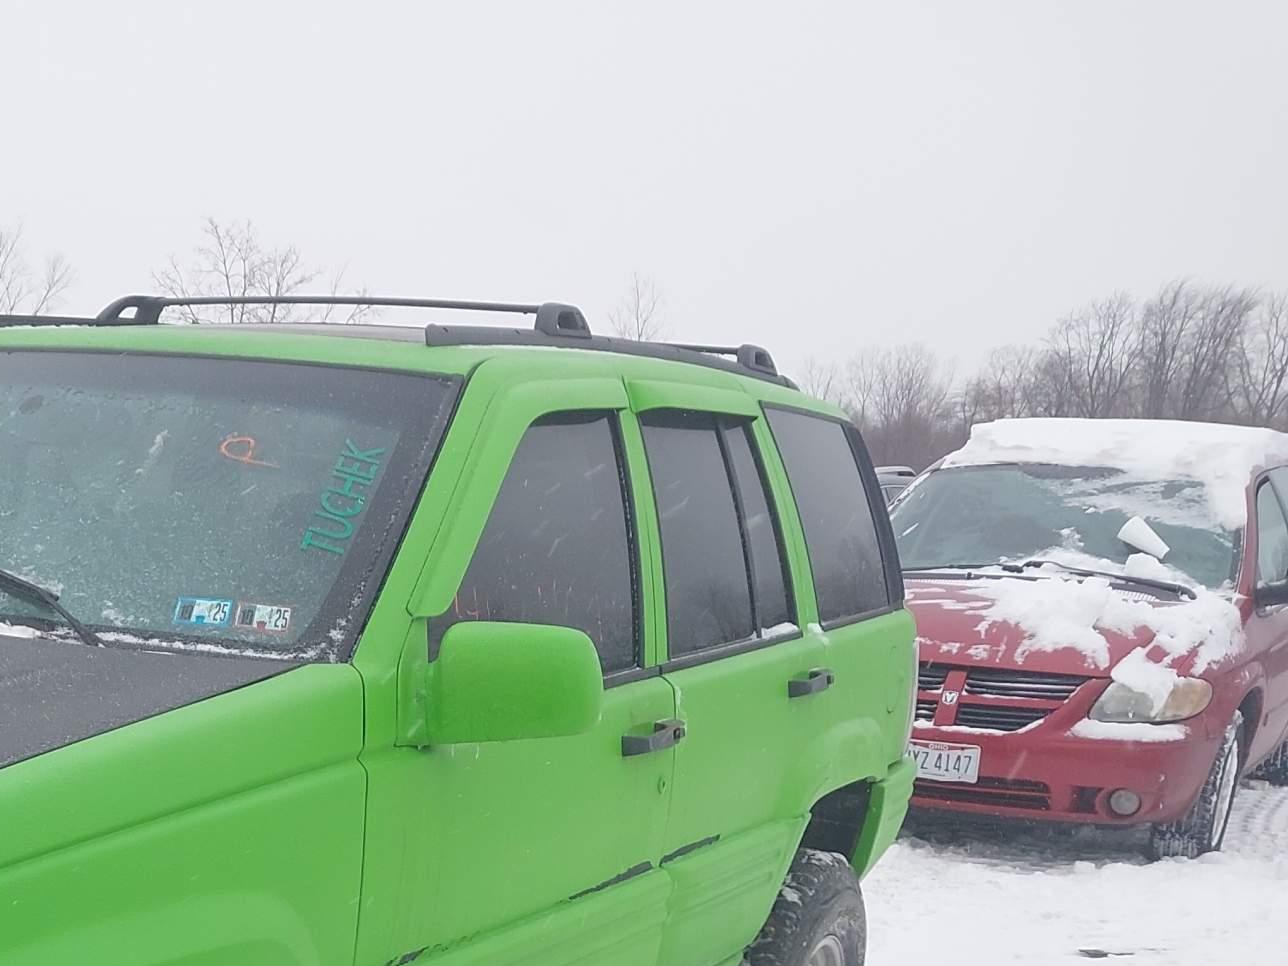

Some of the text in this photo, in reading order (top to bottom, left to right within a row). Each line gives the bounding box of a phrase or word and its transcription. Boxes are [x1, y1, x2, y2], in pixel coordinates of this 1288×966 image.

[220, 435, 280, 468] P
[300, 438, 386, 554] TUCHEK
[213, 602, 229, 622] 25
[274, 608, 290, 629] 25
[907, 749, 972, 774] YZ 4147
